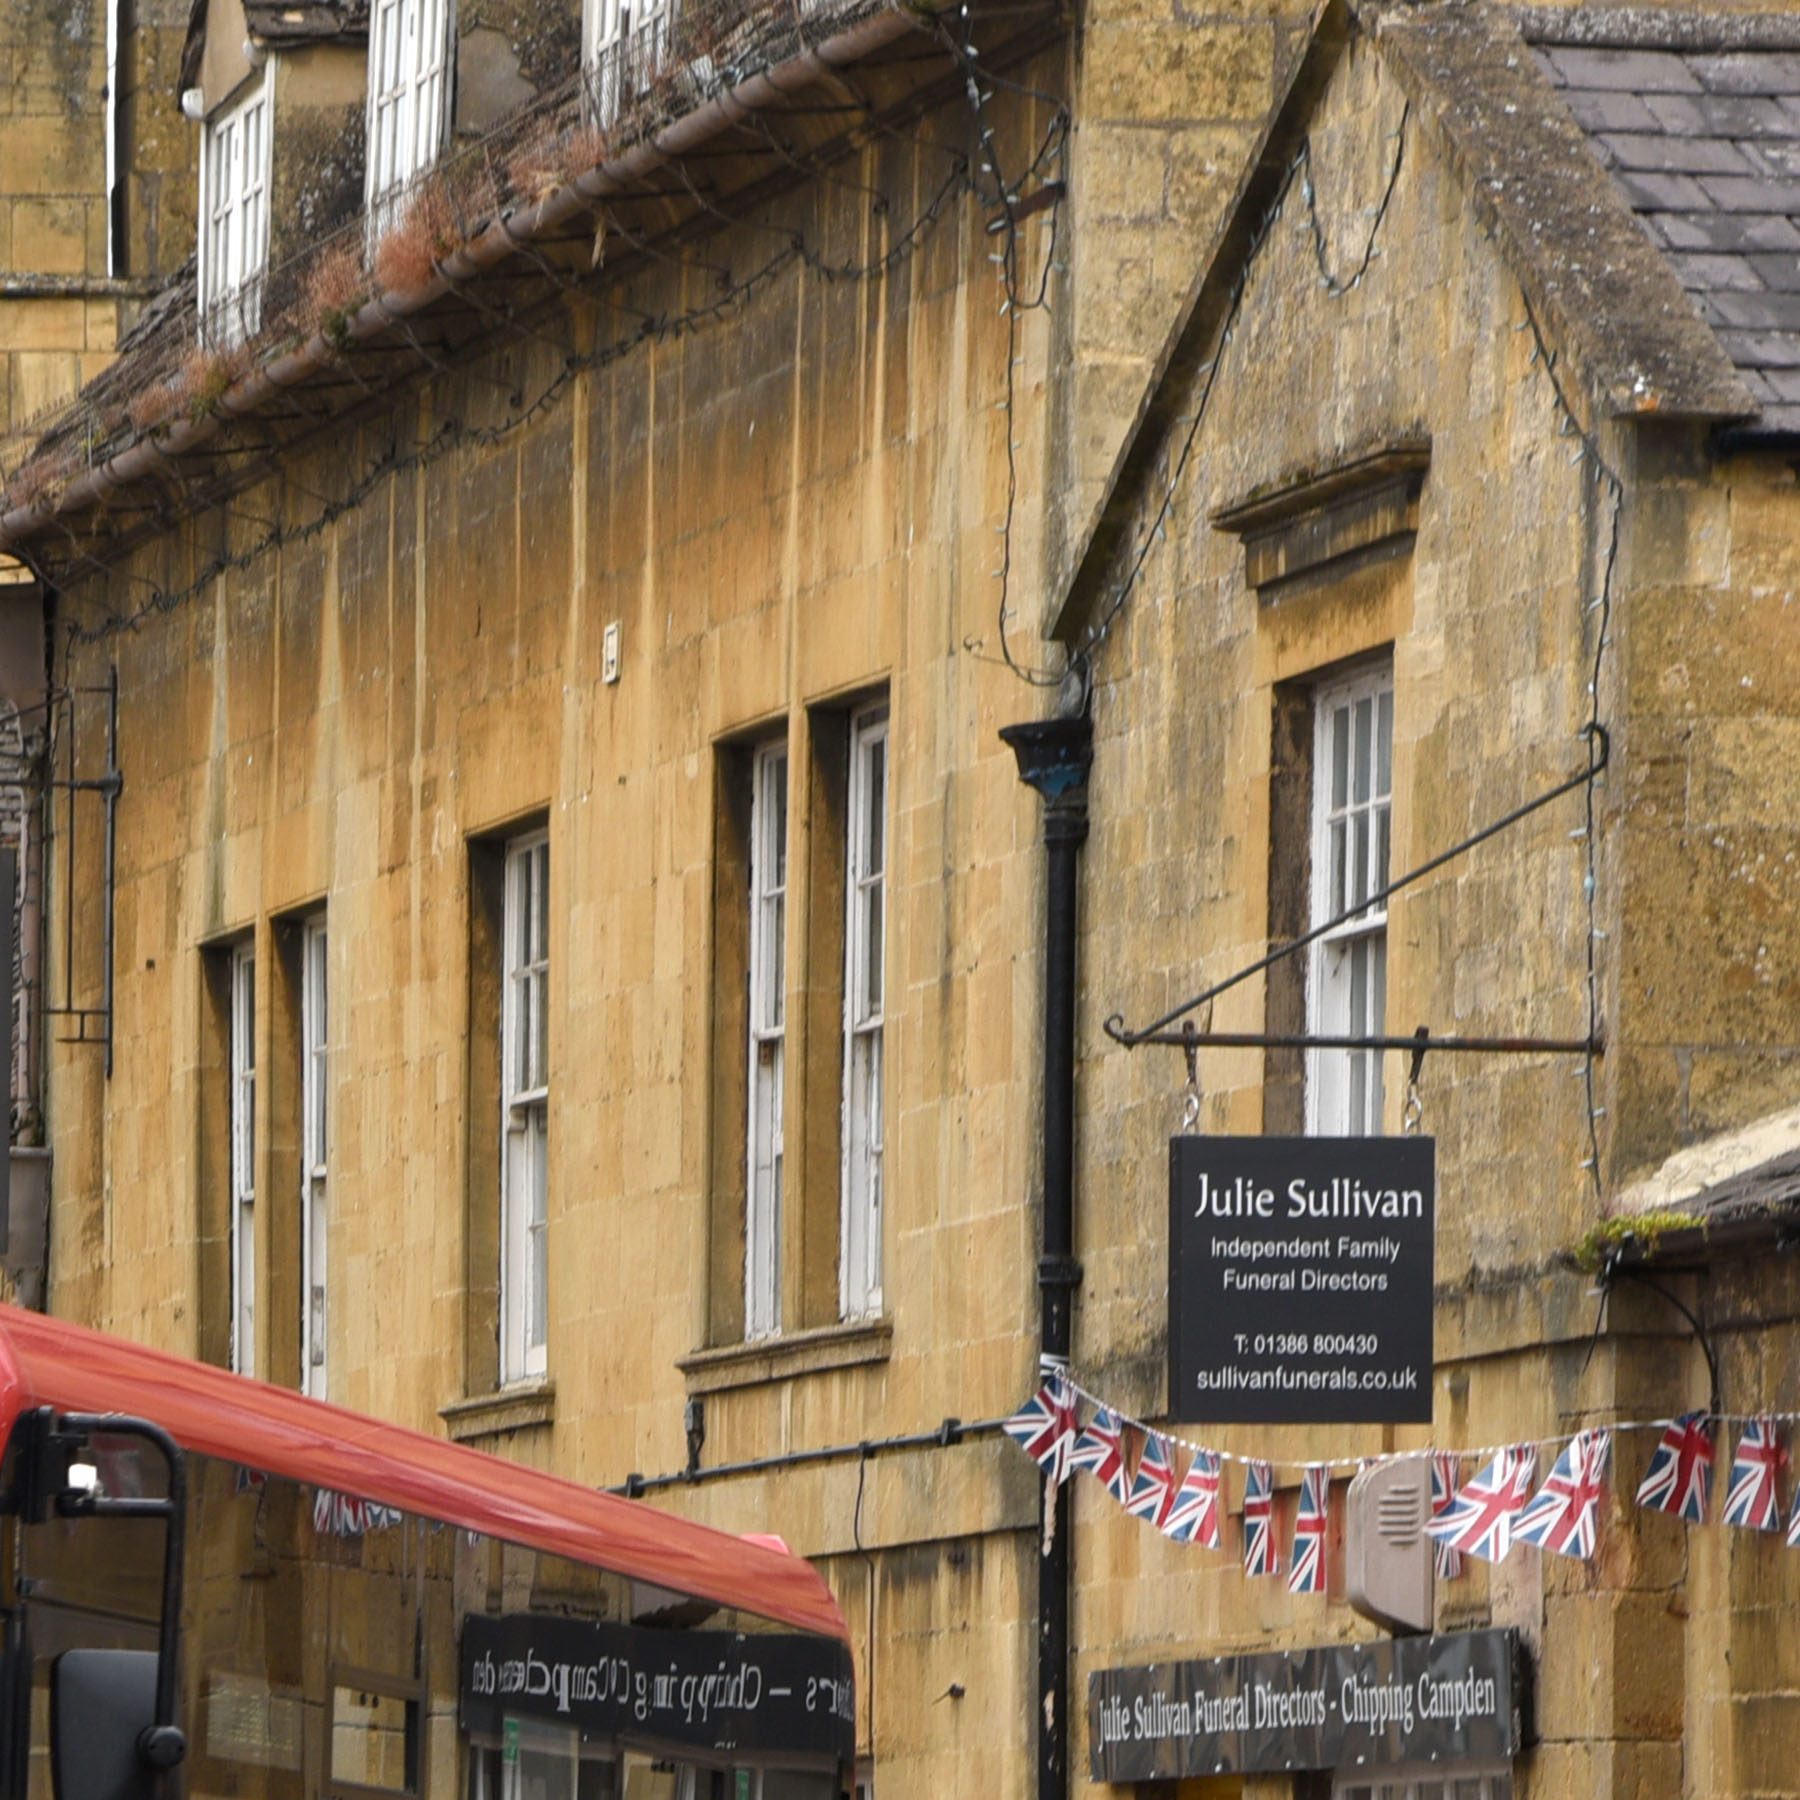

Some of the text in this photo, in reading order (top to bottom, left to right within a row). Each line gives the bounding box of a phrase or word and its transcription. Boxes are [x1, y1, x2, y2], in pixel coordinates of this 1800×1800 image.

[1194, 1172, 1424, 1219] Julie Sullivan
[1210, 1236, 1401, 1263] Independent Family
[1223, 1268, 1389, 1292] Funeral Directors
[1234, 1334, 1379, 1355] T: 01386 800430
[1196, 1364, 1418, 1391] sullivanfunerals.co.uk
[1097, 1697, 1132, 1751] Julie
[1134, 1691, 1191, 1741] Sullivan
[1194, 1684, 1250, 1735] Funeral
[1254, 1679, 1326, 1731] Directors
[1341, 1672, 1414, 1737] Chipping
[1417, 1665, 1496, 1733] Campden
